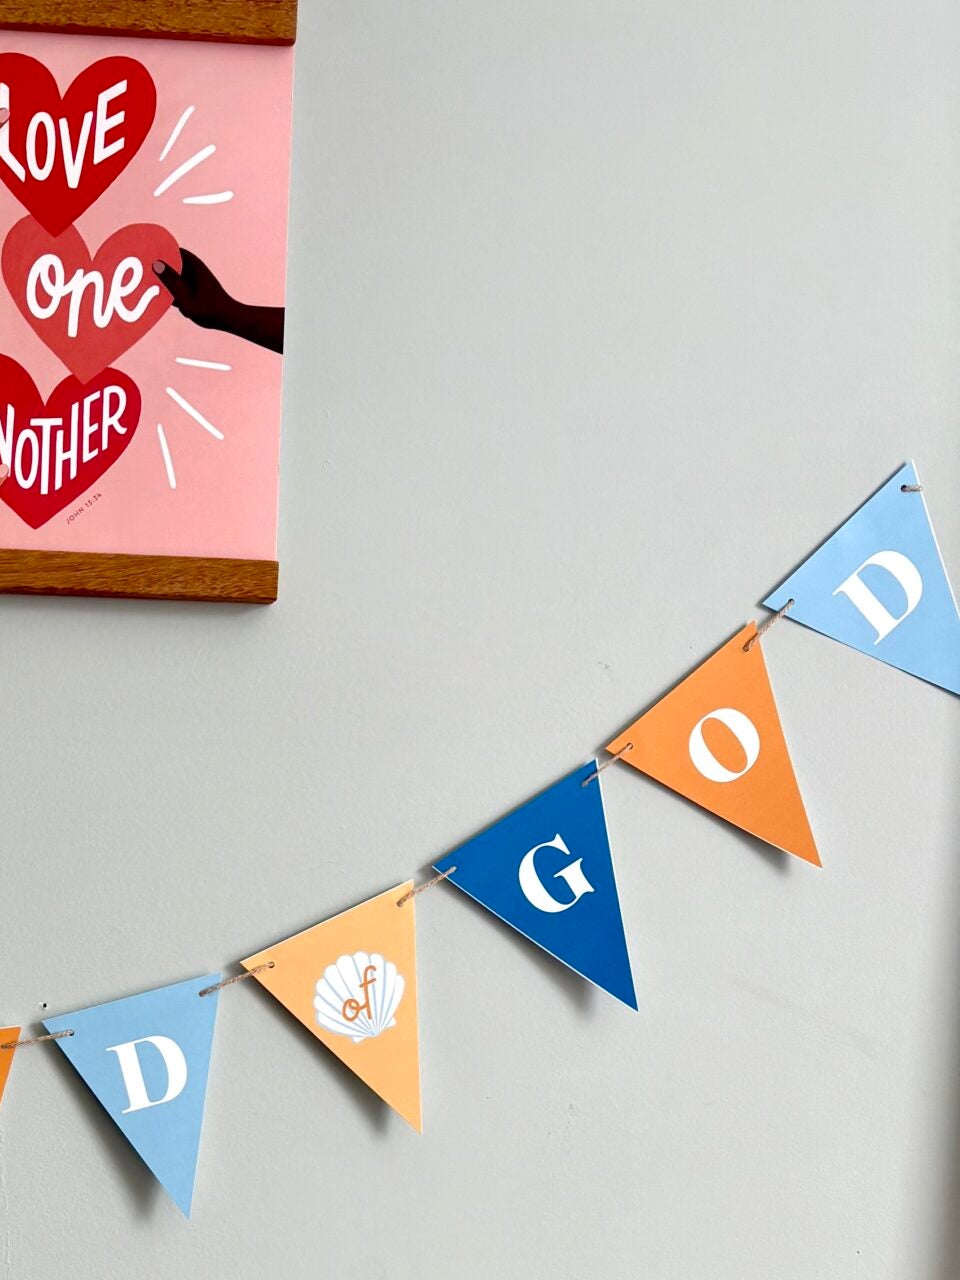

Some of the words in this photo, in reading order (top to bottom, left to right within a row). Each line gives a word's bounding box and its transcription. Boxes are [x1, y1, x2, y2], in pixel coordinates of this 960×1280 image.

[25, 254, 160, 338] one
[66, 506, 84, 525] JOHN
[342, 965, 376, 1022] of
[518, 549, 924, 914] GOD
